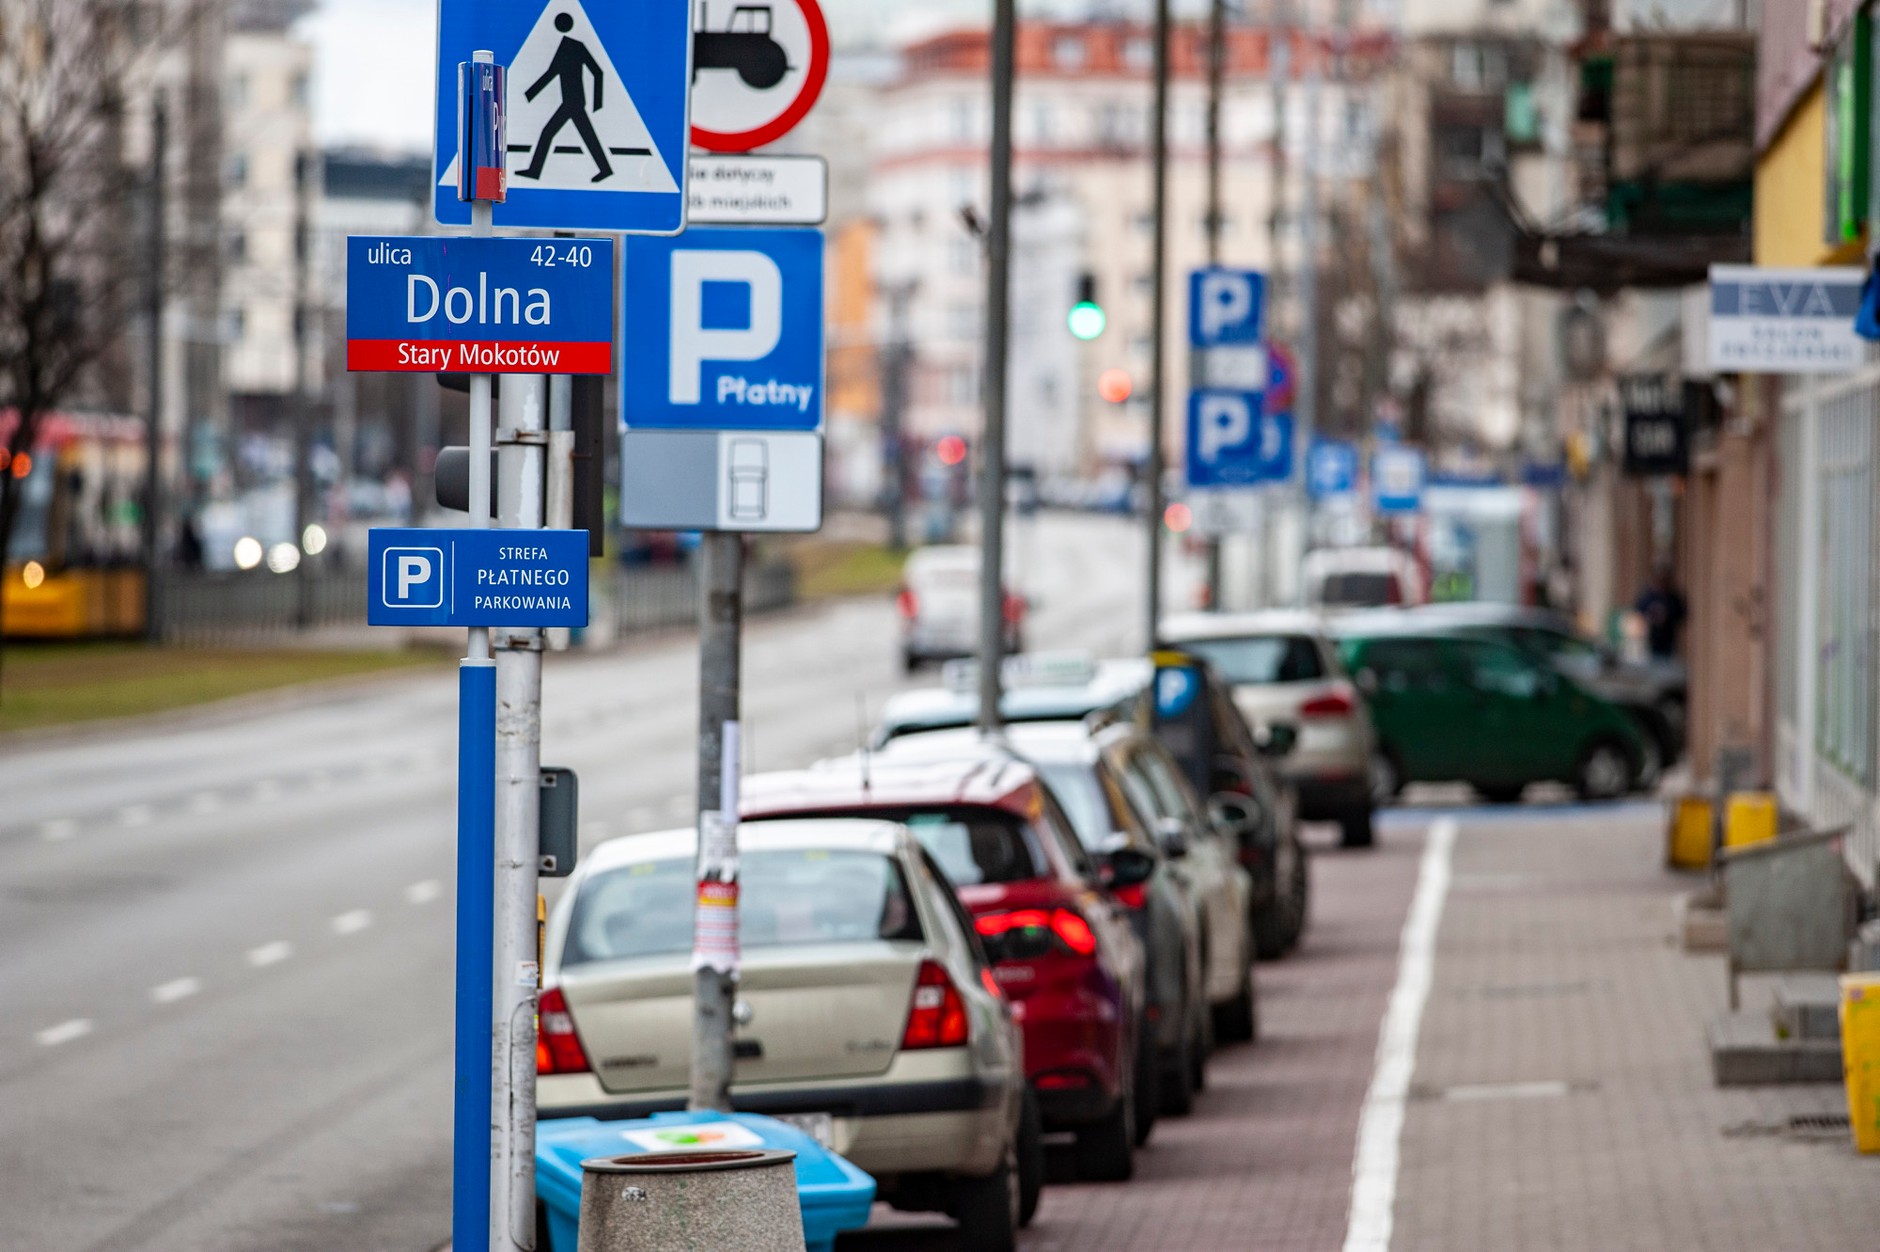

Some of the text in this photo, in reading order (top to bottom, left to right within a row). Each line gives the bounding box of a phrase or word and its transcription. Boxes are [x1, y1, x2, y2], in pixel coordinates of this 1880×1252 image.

[367, 241, 593, 267] ulica 42-40
[406, 271, 551, 326] Dolna
[1200, 273, 1251, 338] P
[1738, 282, 1837, 318] EVA
[669, 250, 783, 405] P
[398, 342, 560, 370] Stary Mokotów
[716, 376, 813, 412] Płatny
[1198, 396, 1249, 462] P
[499, 547, 548, 560] STREFA
[398, 556, 431, 599] P
[477, 569, 570, 586] PŁATNEGO
[474, 596, 571, 609] PARKOWANIA
